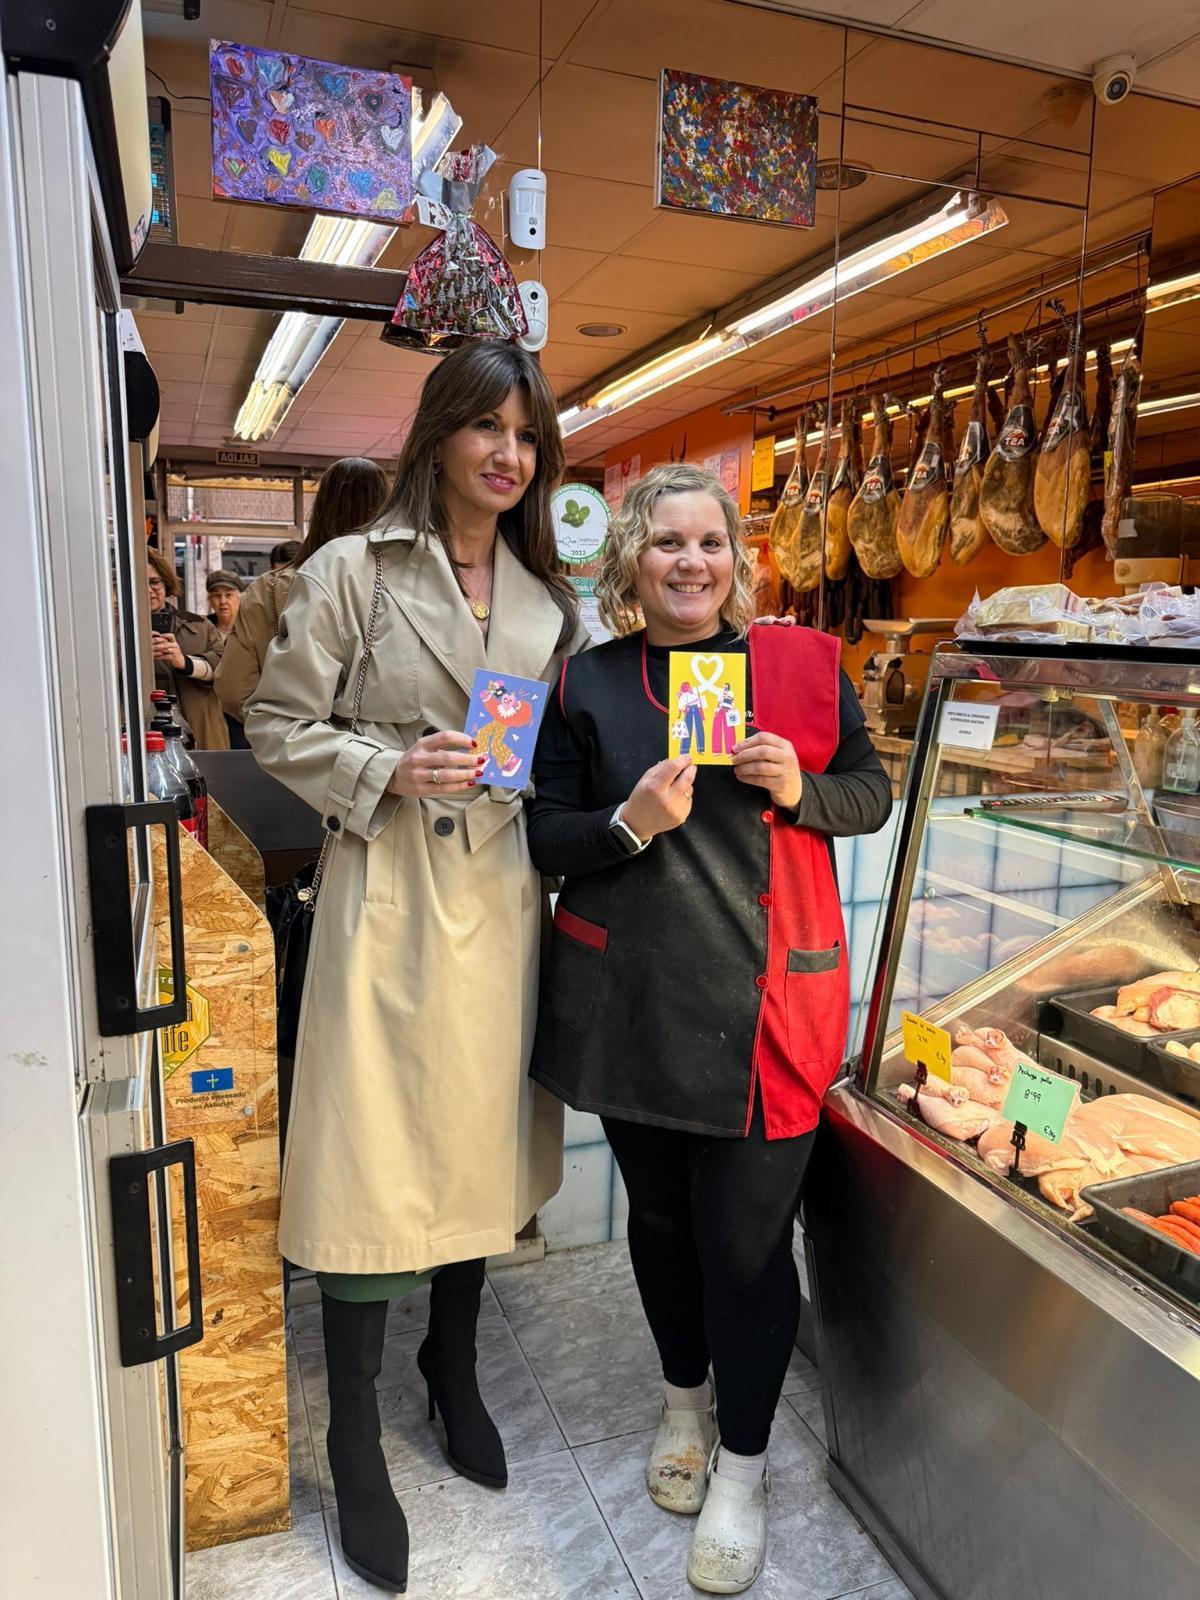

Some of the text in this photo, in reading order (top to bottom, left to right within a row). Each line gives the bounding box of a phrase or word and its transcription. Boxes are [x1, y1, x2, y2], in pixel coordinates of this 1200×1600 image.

[175, 1091, 247, 1104] Producto envasado
[203, 1101, 234, 1109] Asturias
